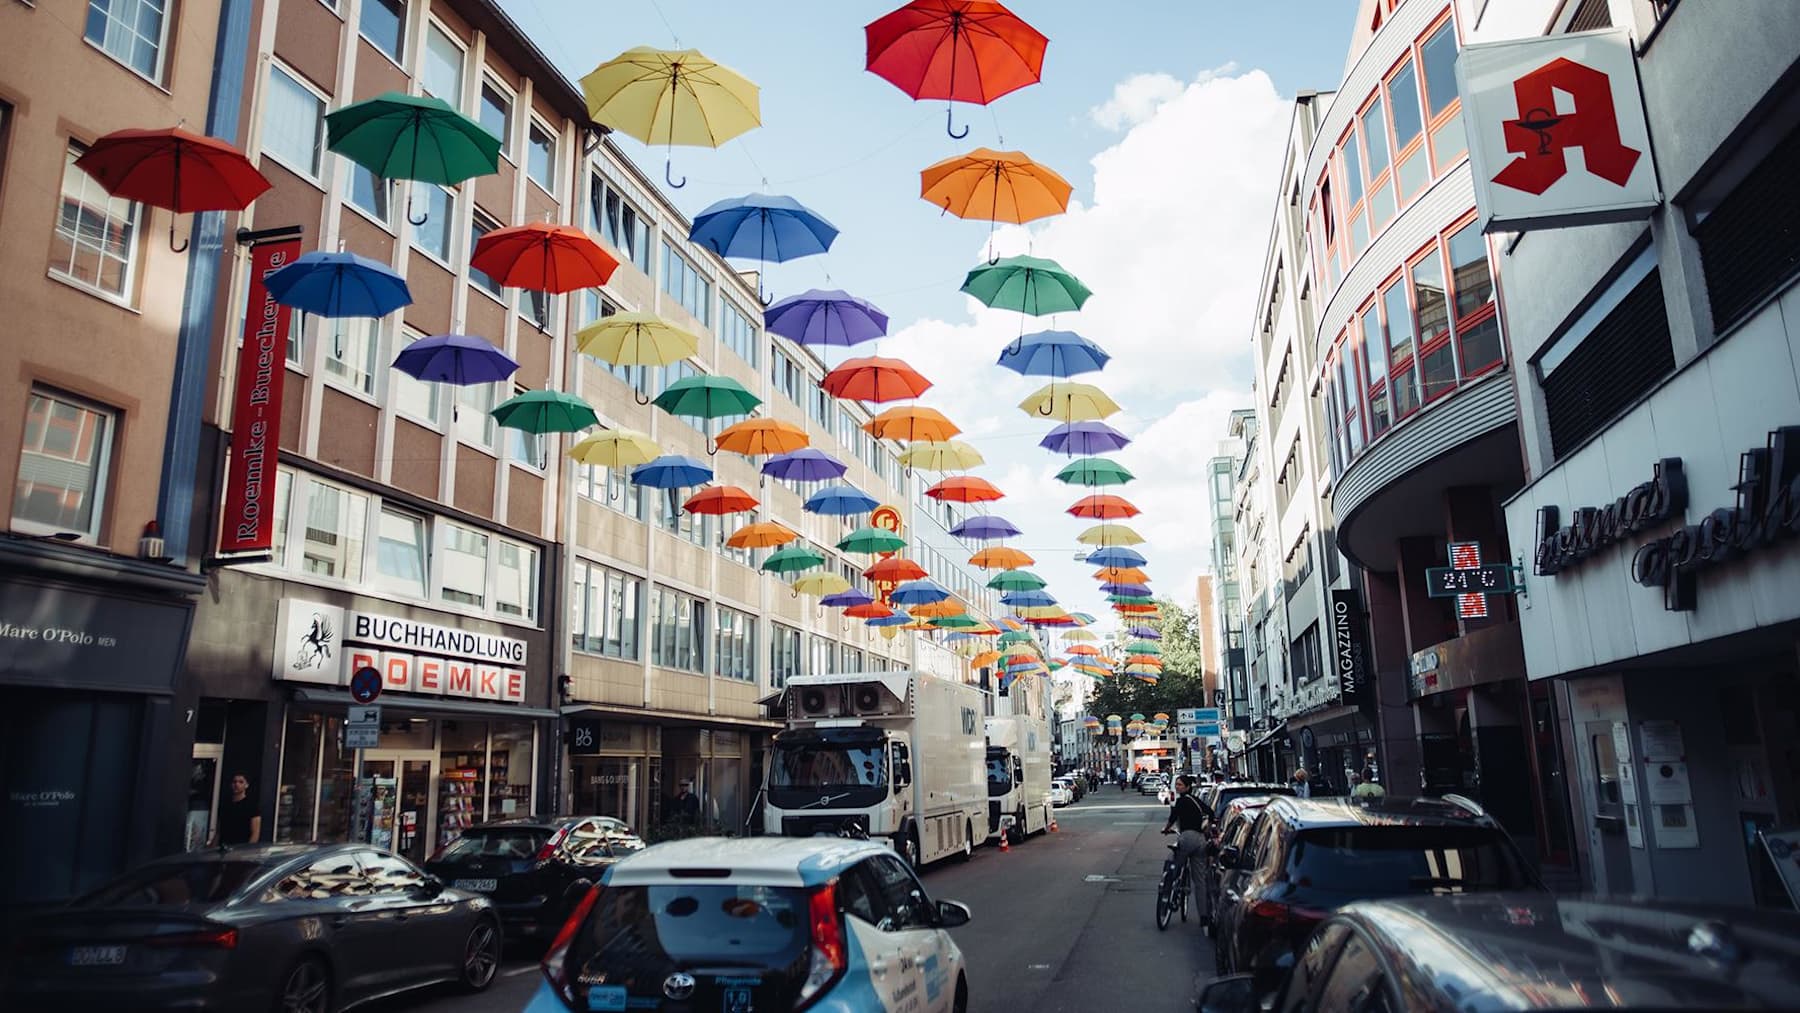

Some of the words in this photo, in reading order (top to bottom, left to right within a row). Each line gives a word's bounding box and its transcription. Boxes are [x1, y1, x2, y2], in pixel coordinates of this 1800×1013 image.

[0, 623, 38, 639] Marc
[43, 628, 93, 645] O'Polo
[355, 614, 523, 661] BUCHHANDLUNG
[1335, 601, 1355, 693] MAGAZZINO
[186, 710, 194, 723] 7
